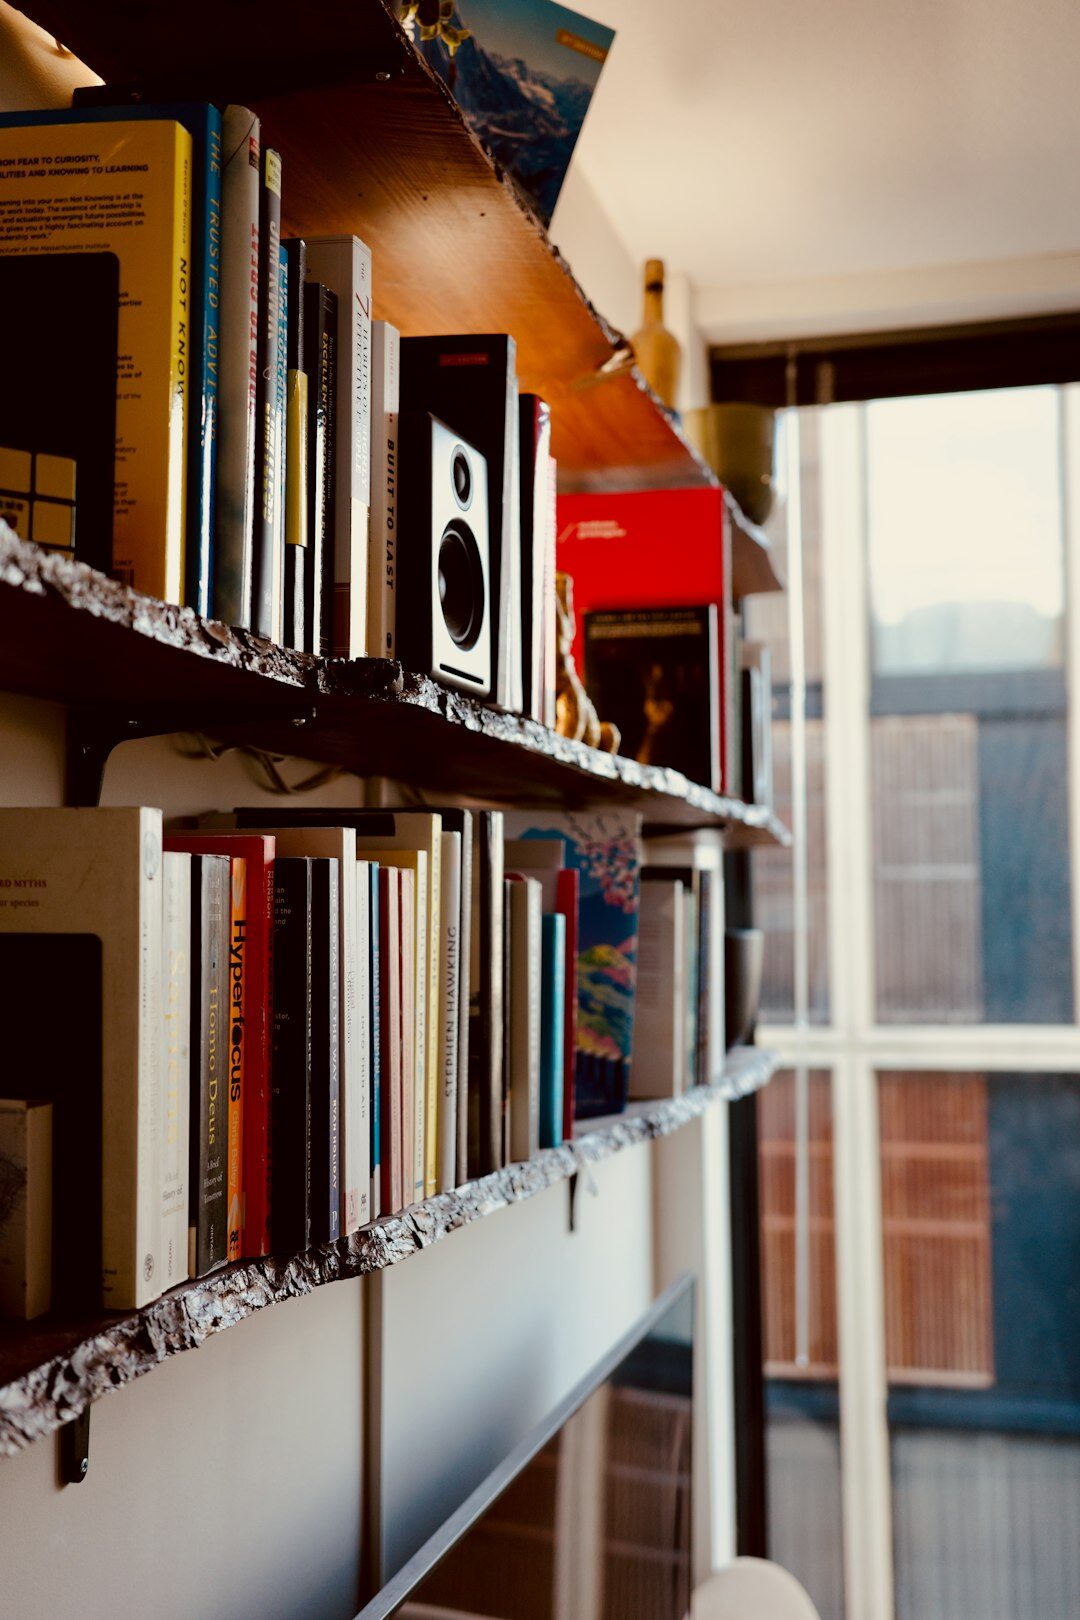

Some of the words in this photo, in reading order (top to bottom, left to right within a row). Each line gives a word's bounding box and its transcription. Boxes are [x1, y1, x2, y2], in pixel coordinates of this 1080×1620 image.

[18, 157, 39, 166] FEAR
[42, 156, 53, 164] TO
[54, 154, 100, 164] CURIOSITY,
[210, 130, 221, 177] THE
[28, 169, 46, 177] AND
[48, 167, 89, 176] KNOWING
[92, 166, 103, 174] TO
[105, 164, 149, 173] LEARNING
[25, 206, 45, 215] today.
[98, 202, 134, 210] leadership
[37, 198, 52, 206] your
[84, 194, 114, 203] Knowing
[6, 224, 24, 233] gives
[25, 224, 38, 232] you
[45, 222, 65, 231] highly
[67, 220, 104, 229] fascinating
[105, 220, 133, 228] account
[52, 213, 83, 222] emerging
[208, 198, 220, 309] TRUSTED
[269, 220, 280, 268] JIM
[179, 257, 187, 312] NOT
[355, 290, 370, 321] 7
[362, 396, 368, 416] OF
[387, 437, 395, 500] BUILT
[386, 505, 395, 531] TO
[386, 539, 394, 591] LAST
[14, 879, 47, 888] MYTHS
[10, 896, 39, 909] species
[281, 907, 292, 915] the
[446, 926, 457, 1013] HAWKING
[230, 919, 247, 1103] Hyperfocus
[331, 995, 337, 1010] IS
[209, 987, 218, 1072] Homo
[445, 1020, 455, 1098] STEPHEN
[208, 1077, 218, 1145] Deus
[231, 1110, 239, 1145] Chris
[230, 1149, 238, 1189] Bailey
